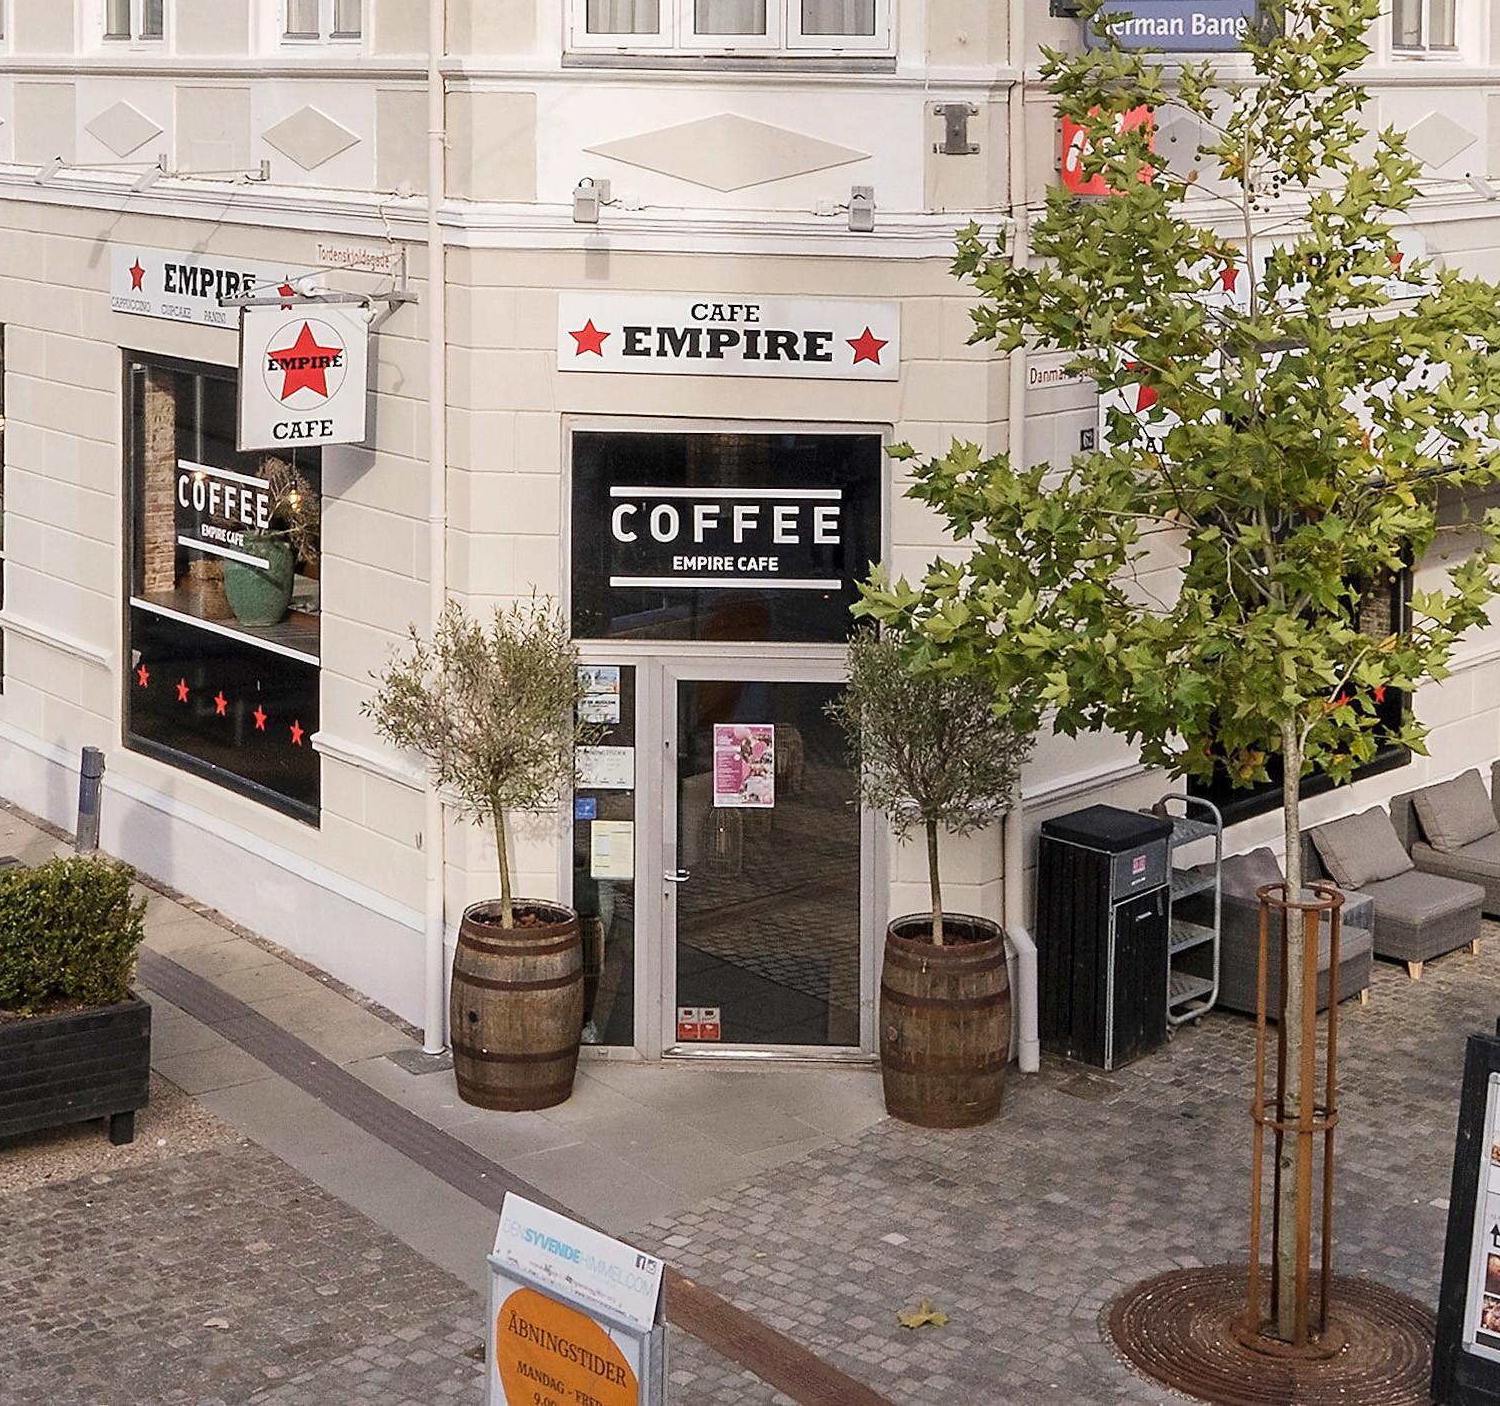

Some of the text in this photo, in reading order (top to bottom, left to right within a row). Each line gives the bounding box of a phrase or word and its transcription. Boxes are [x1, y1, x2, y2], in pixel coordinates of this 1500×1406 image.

[1100, 12, 1248, 41] erman Bang
[164, 263, 256, 300] EMPIRE
[691, 303, 761, 324] CAFE
[622, 326, 834, 363] EMPIRE
[267, 354, 344, 372] EMPIRE
[272, 419, 334, 441] CAFE
[178, 474, 269, 530] COFFEE
[201, 523, 245, 547] EMPIRE CAFE
[611, 502, 841, 545] COFFEE
[673, 556, 780, 572] EMPIRE CAFE
[508, 1310, 627, 1388] ÅBNINGSTIDER
[516, 1360, 565, 1395] MANDAG
